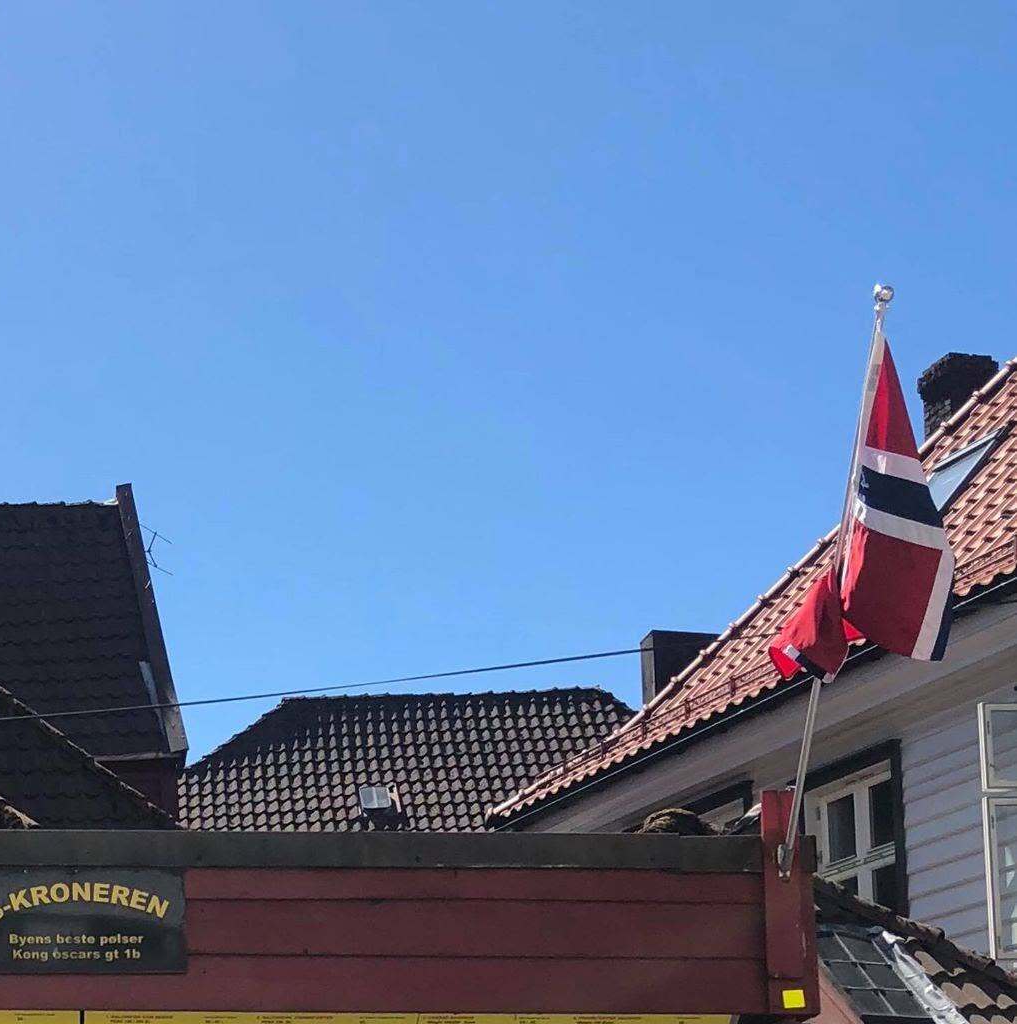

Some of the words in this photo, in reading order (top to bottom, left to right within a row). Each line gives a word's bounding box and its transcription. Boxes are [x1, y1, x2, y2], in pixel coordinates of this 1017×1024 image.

[9, 934, 51, 947] Byens
[56, 934, 95, 944] beste
[12, 949, 49, 962] Kong
[105, 949, 119, 962] gt
